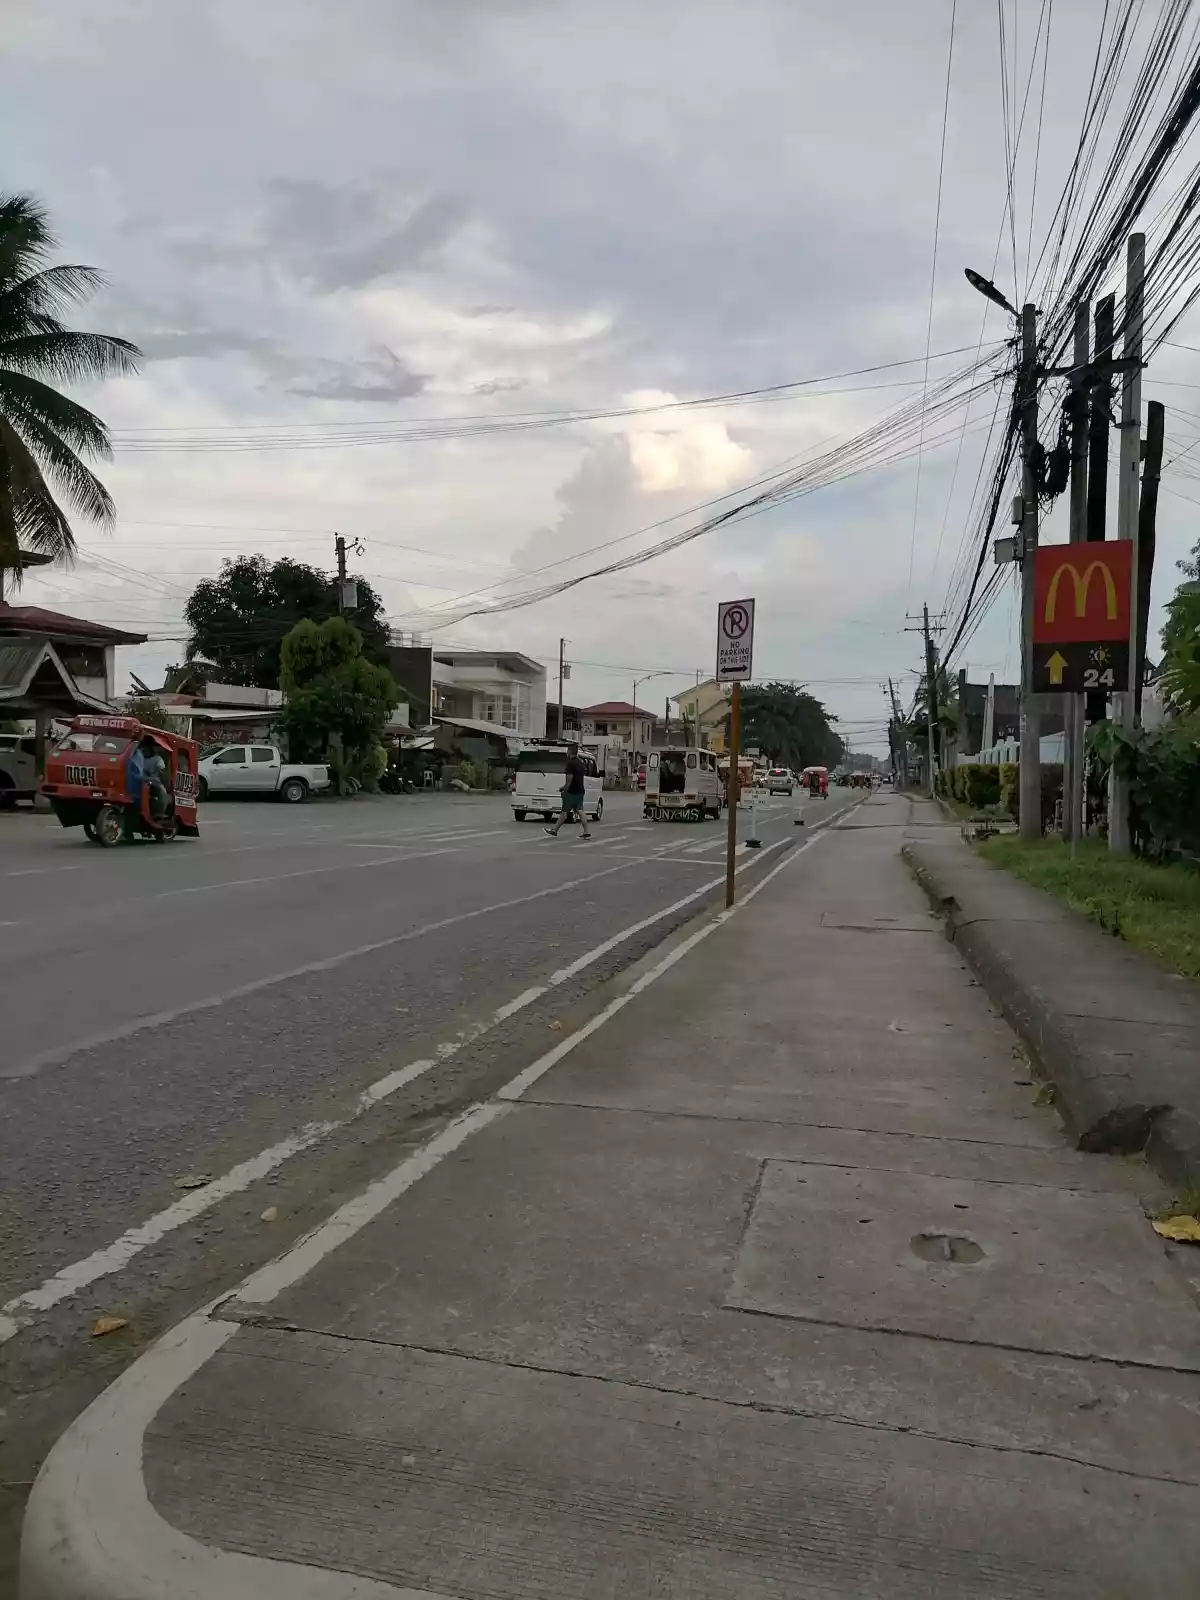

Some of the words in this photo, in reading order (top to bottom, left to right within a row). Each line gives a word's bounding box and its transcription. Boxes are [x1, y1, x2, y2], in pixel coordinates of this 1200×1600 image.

[720, 648, 749, 657] PARKING
[1083, 668, 1115, 687] 24
[66, 766, 97, 786] 0029
[175, 773, 195, 793] 0029
